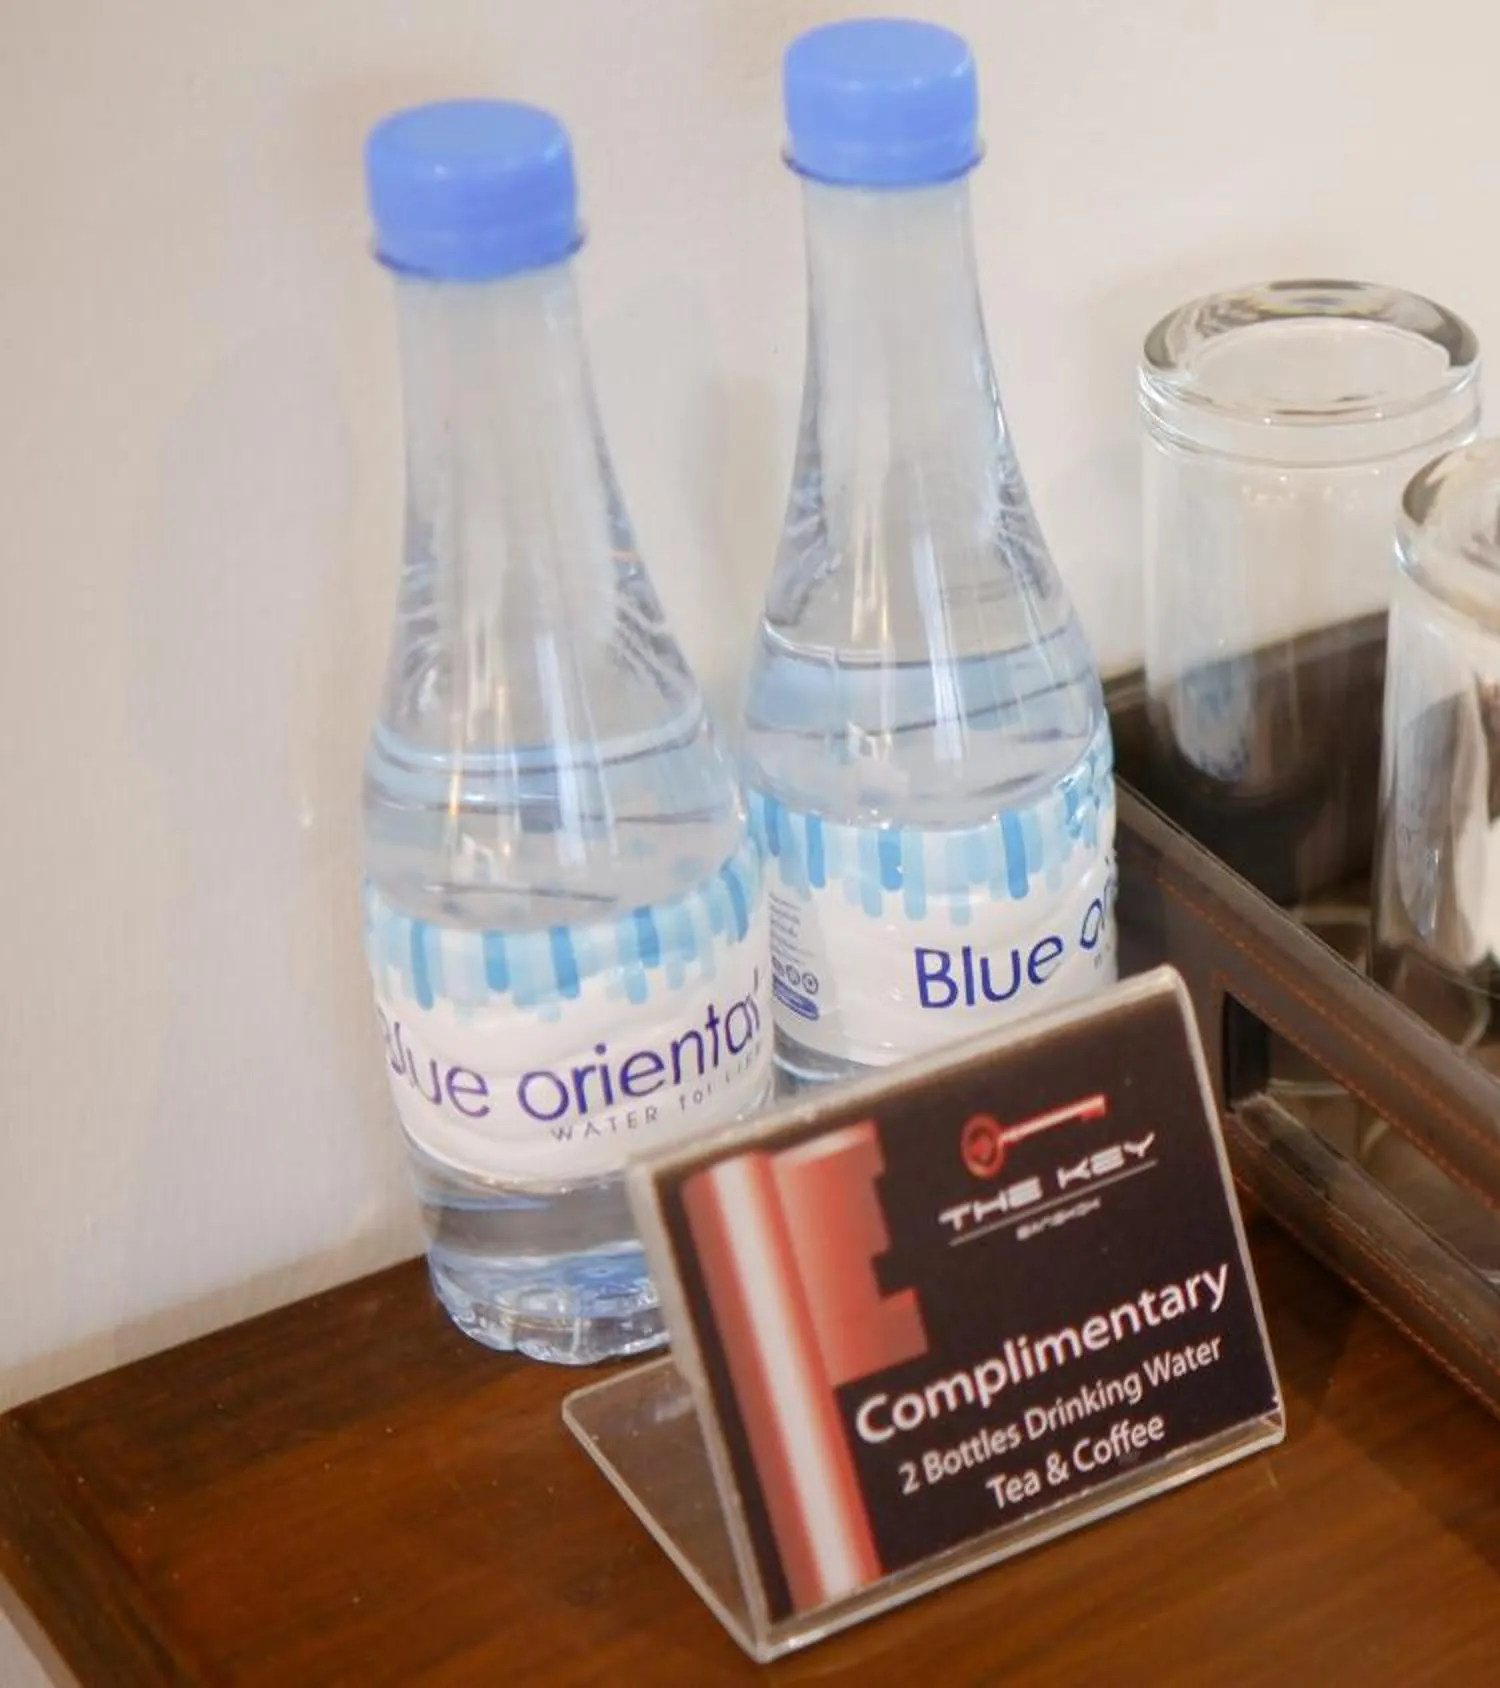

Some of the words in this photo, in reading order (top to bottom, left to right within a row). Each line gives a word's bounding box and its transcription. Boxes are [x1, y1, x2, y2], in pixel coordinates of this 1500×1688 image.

[914, 935, 1065, 1010] Blue
[549, 1106, 660, 1142] WATER
[938, 1176, 1043, 1231] THE
[1056, 1131, 1156, 1190] KEY
[854, 1264, 1229, 1446] Complimentary
[898, 1461, 922, 1496] 2
[922, 1421, 1022, 1485] Bottles
[1024, 1369, 1143, 1441] Drinking
[1143, 1336, 1223, 1392] Water
[986, 1470, 1041, 1509] Tea
[1045, 1453, 1071, 1487] &
[1072, 1412, 1166, 1473] Coffee
